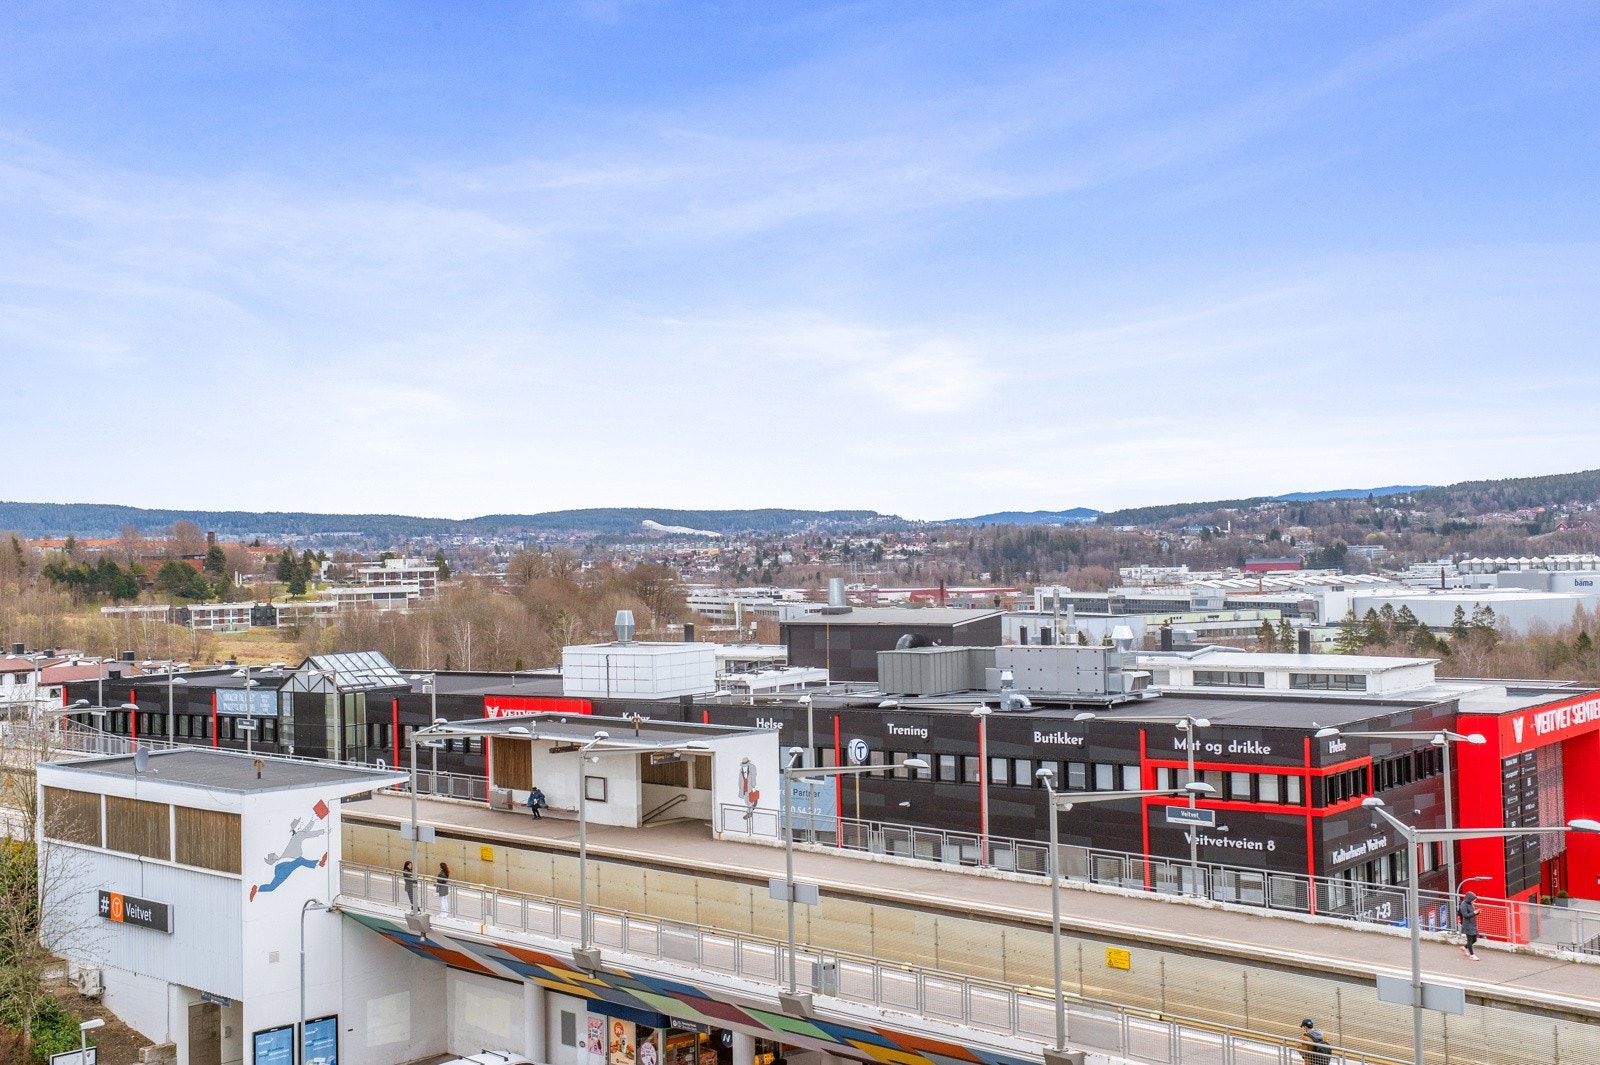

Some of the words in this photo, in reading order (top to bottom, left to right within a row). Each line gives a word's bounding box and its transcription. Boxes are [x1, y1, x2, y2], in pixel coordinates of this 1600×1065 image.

[756, 717, 784, 730] Helse
[1533, 705, 1571, 736] VEITVET
[887, 723, 928, 739] Trening
[1033, 731, 1084, 746] Butikker
[1205, 743, 1222, 755] og
[1228, 740, 1271, 755] drikke
[1328, 738, 1347, 754] Helse
[1180, 810, 1199, 818] Veitvet
[1184, 832, 1263, 851] Veitvetveien
[1267, 840, 1276, 852] 8
[125, 902, 152, 922] Veitvet
